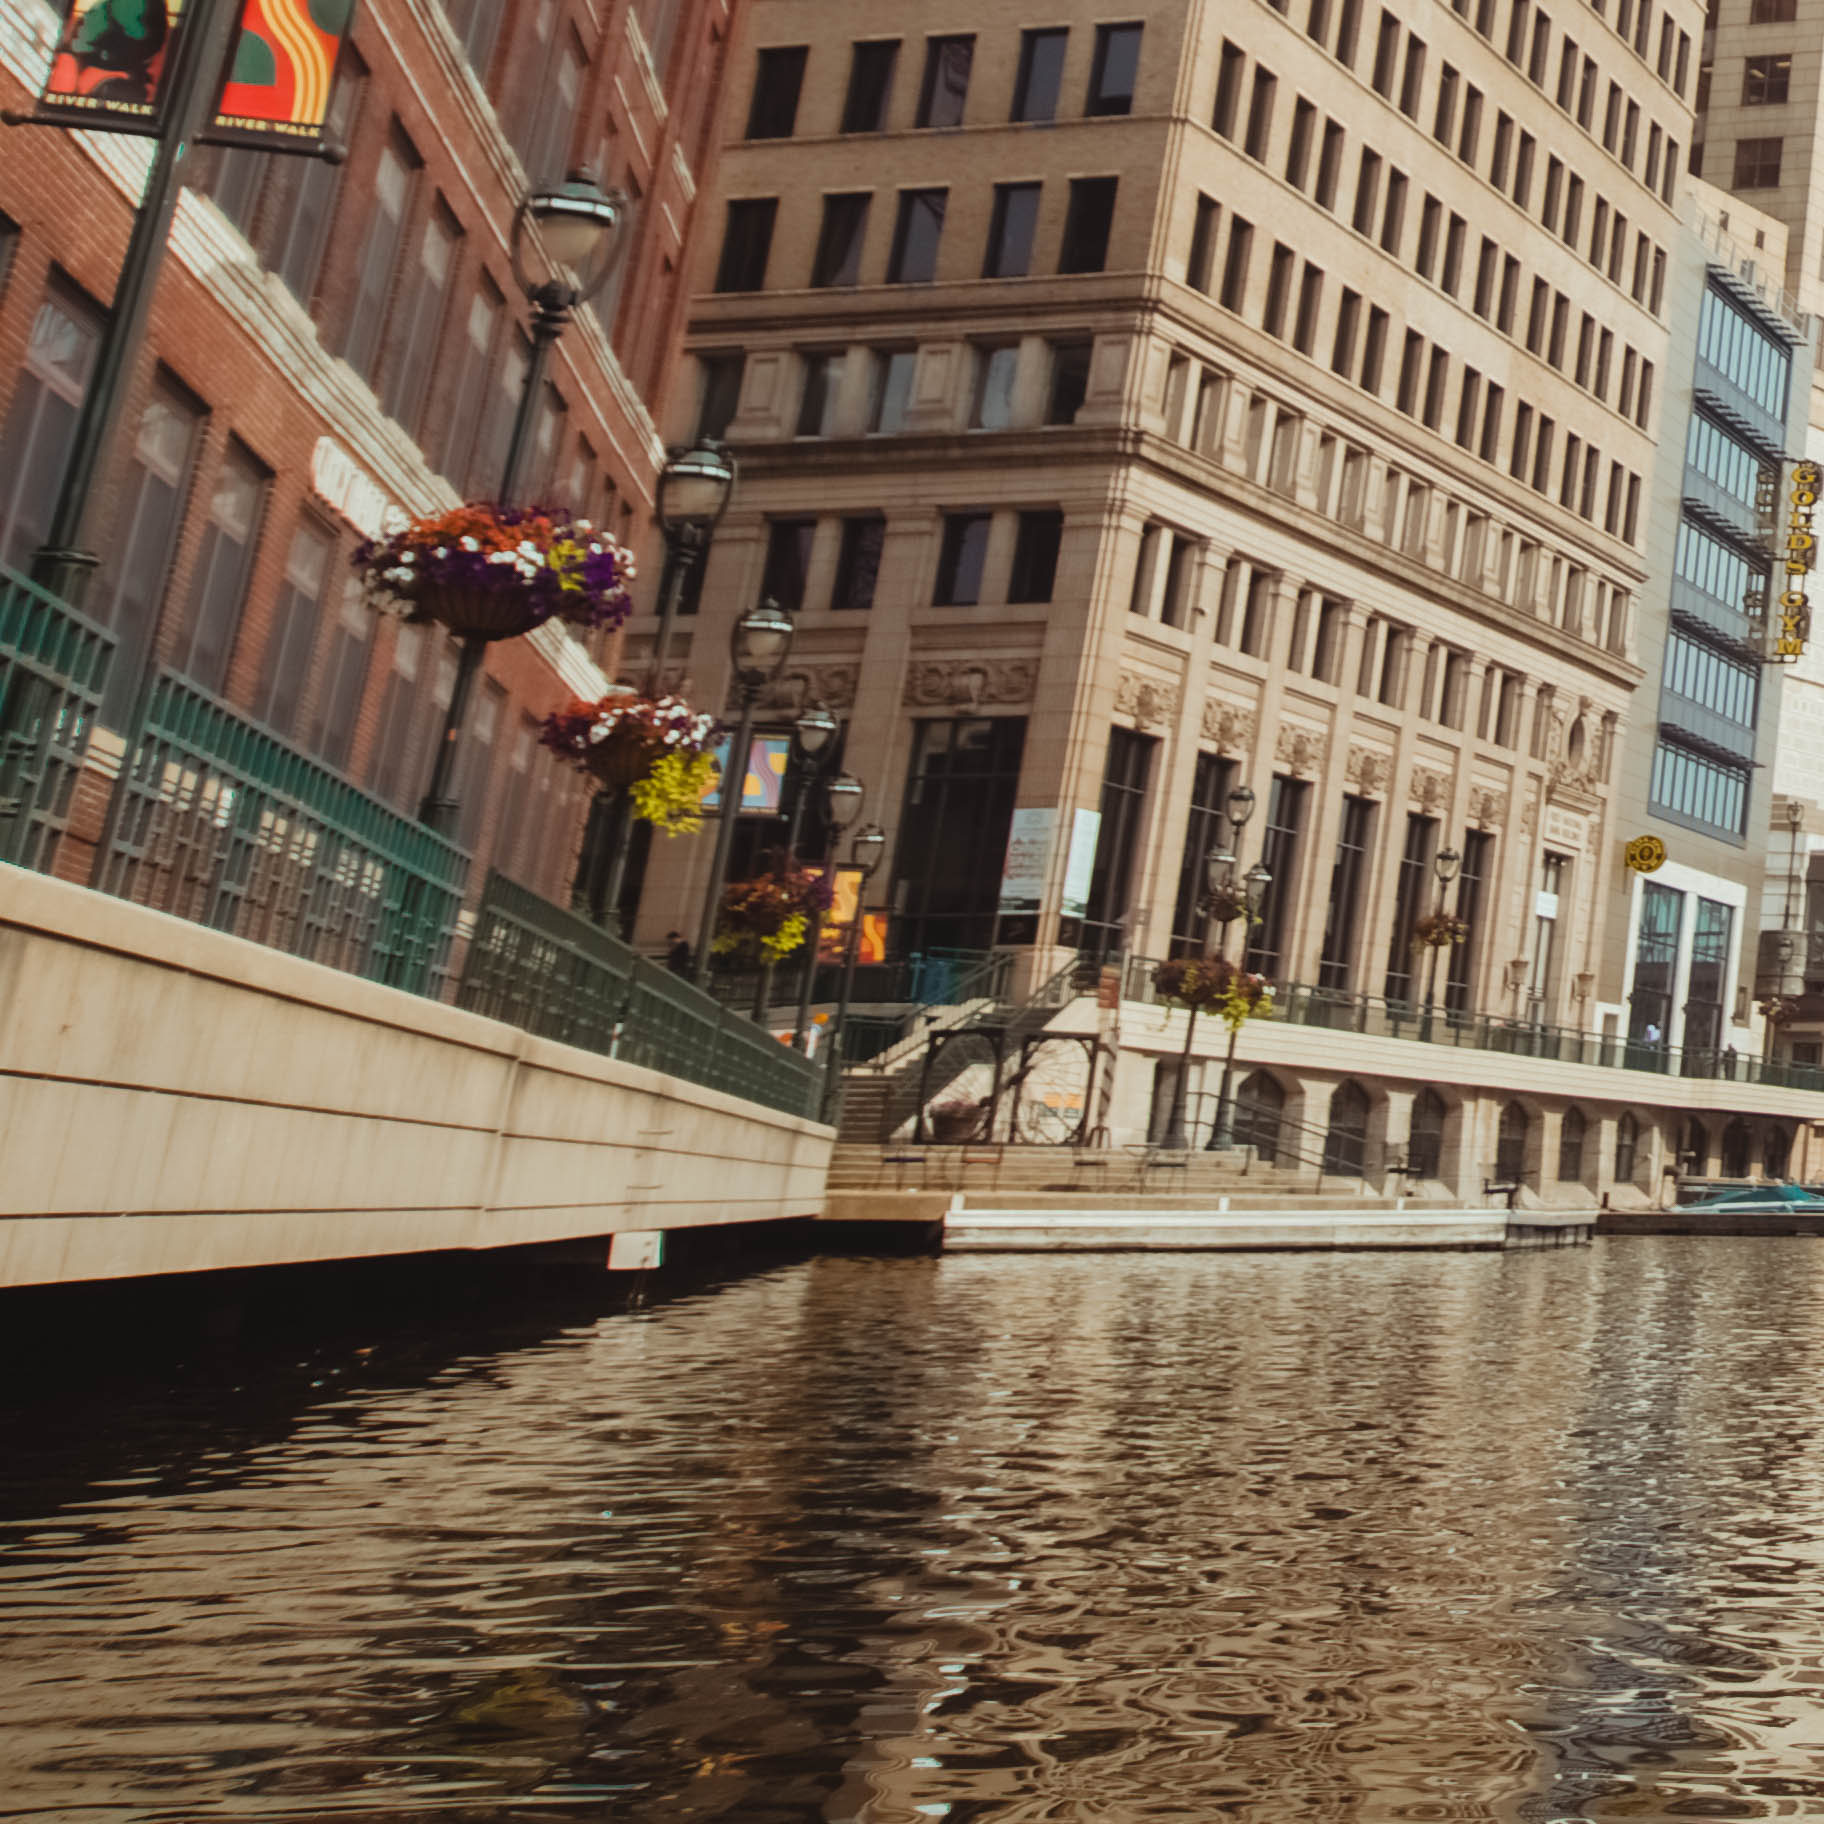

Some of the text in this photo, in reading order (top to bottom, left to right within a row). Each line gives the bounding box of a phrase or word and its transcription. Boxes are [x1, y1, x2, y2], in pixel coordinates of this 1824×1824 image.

[46, 93, 154, 115] RIVER WALK
[215, 115, 320, 138] RIVER WALK
[1777, 590, 1808, 656] GYM
